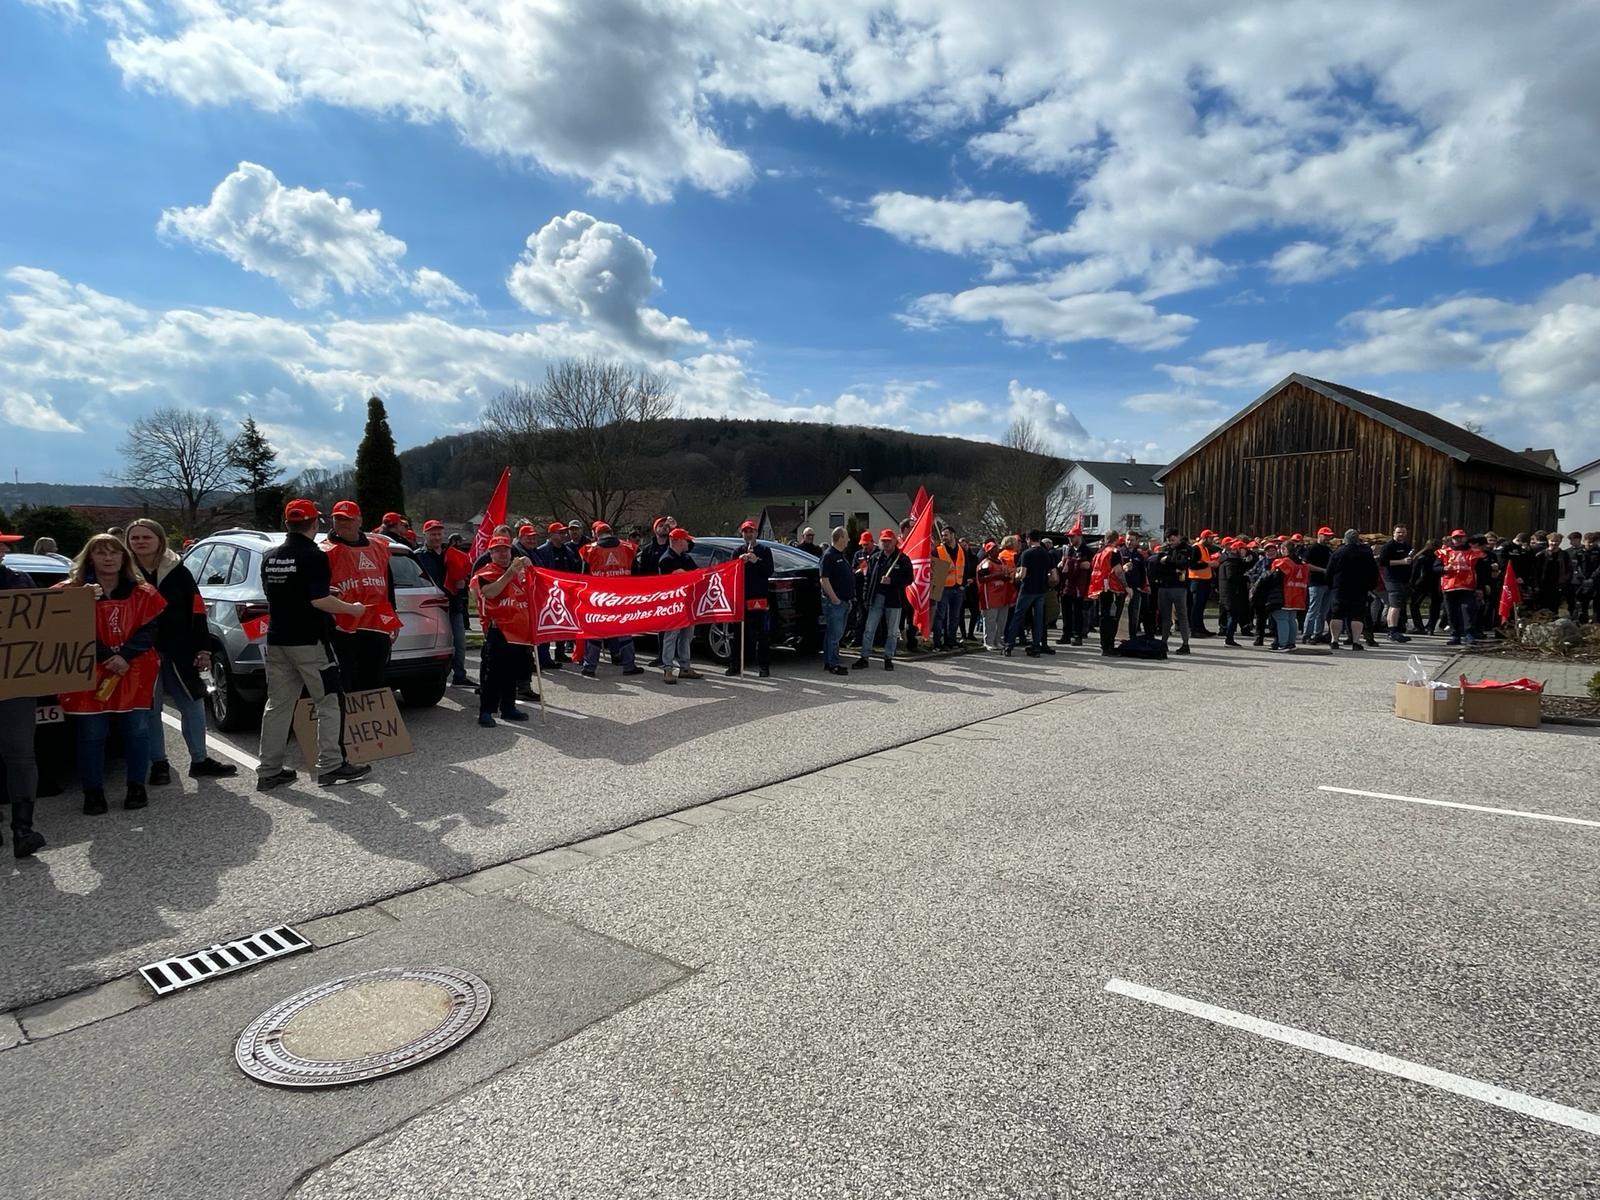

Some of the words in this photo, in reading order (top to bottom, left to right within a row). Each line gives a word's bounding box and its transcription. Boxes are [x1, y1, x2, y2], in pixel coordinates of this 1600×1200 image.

[337, 577, 359, 592] Wir
[589, 585, 689, 607] Warnstreik
[584, 611, 622, 624] unser
[620, 608, 653, 624] gutes
[654, 602, 685, 617] Recht
[36, 708, 59, 721] 16
